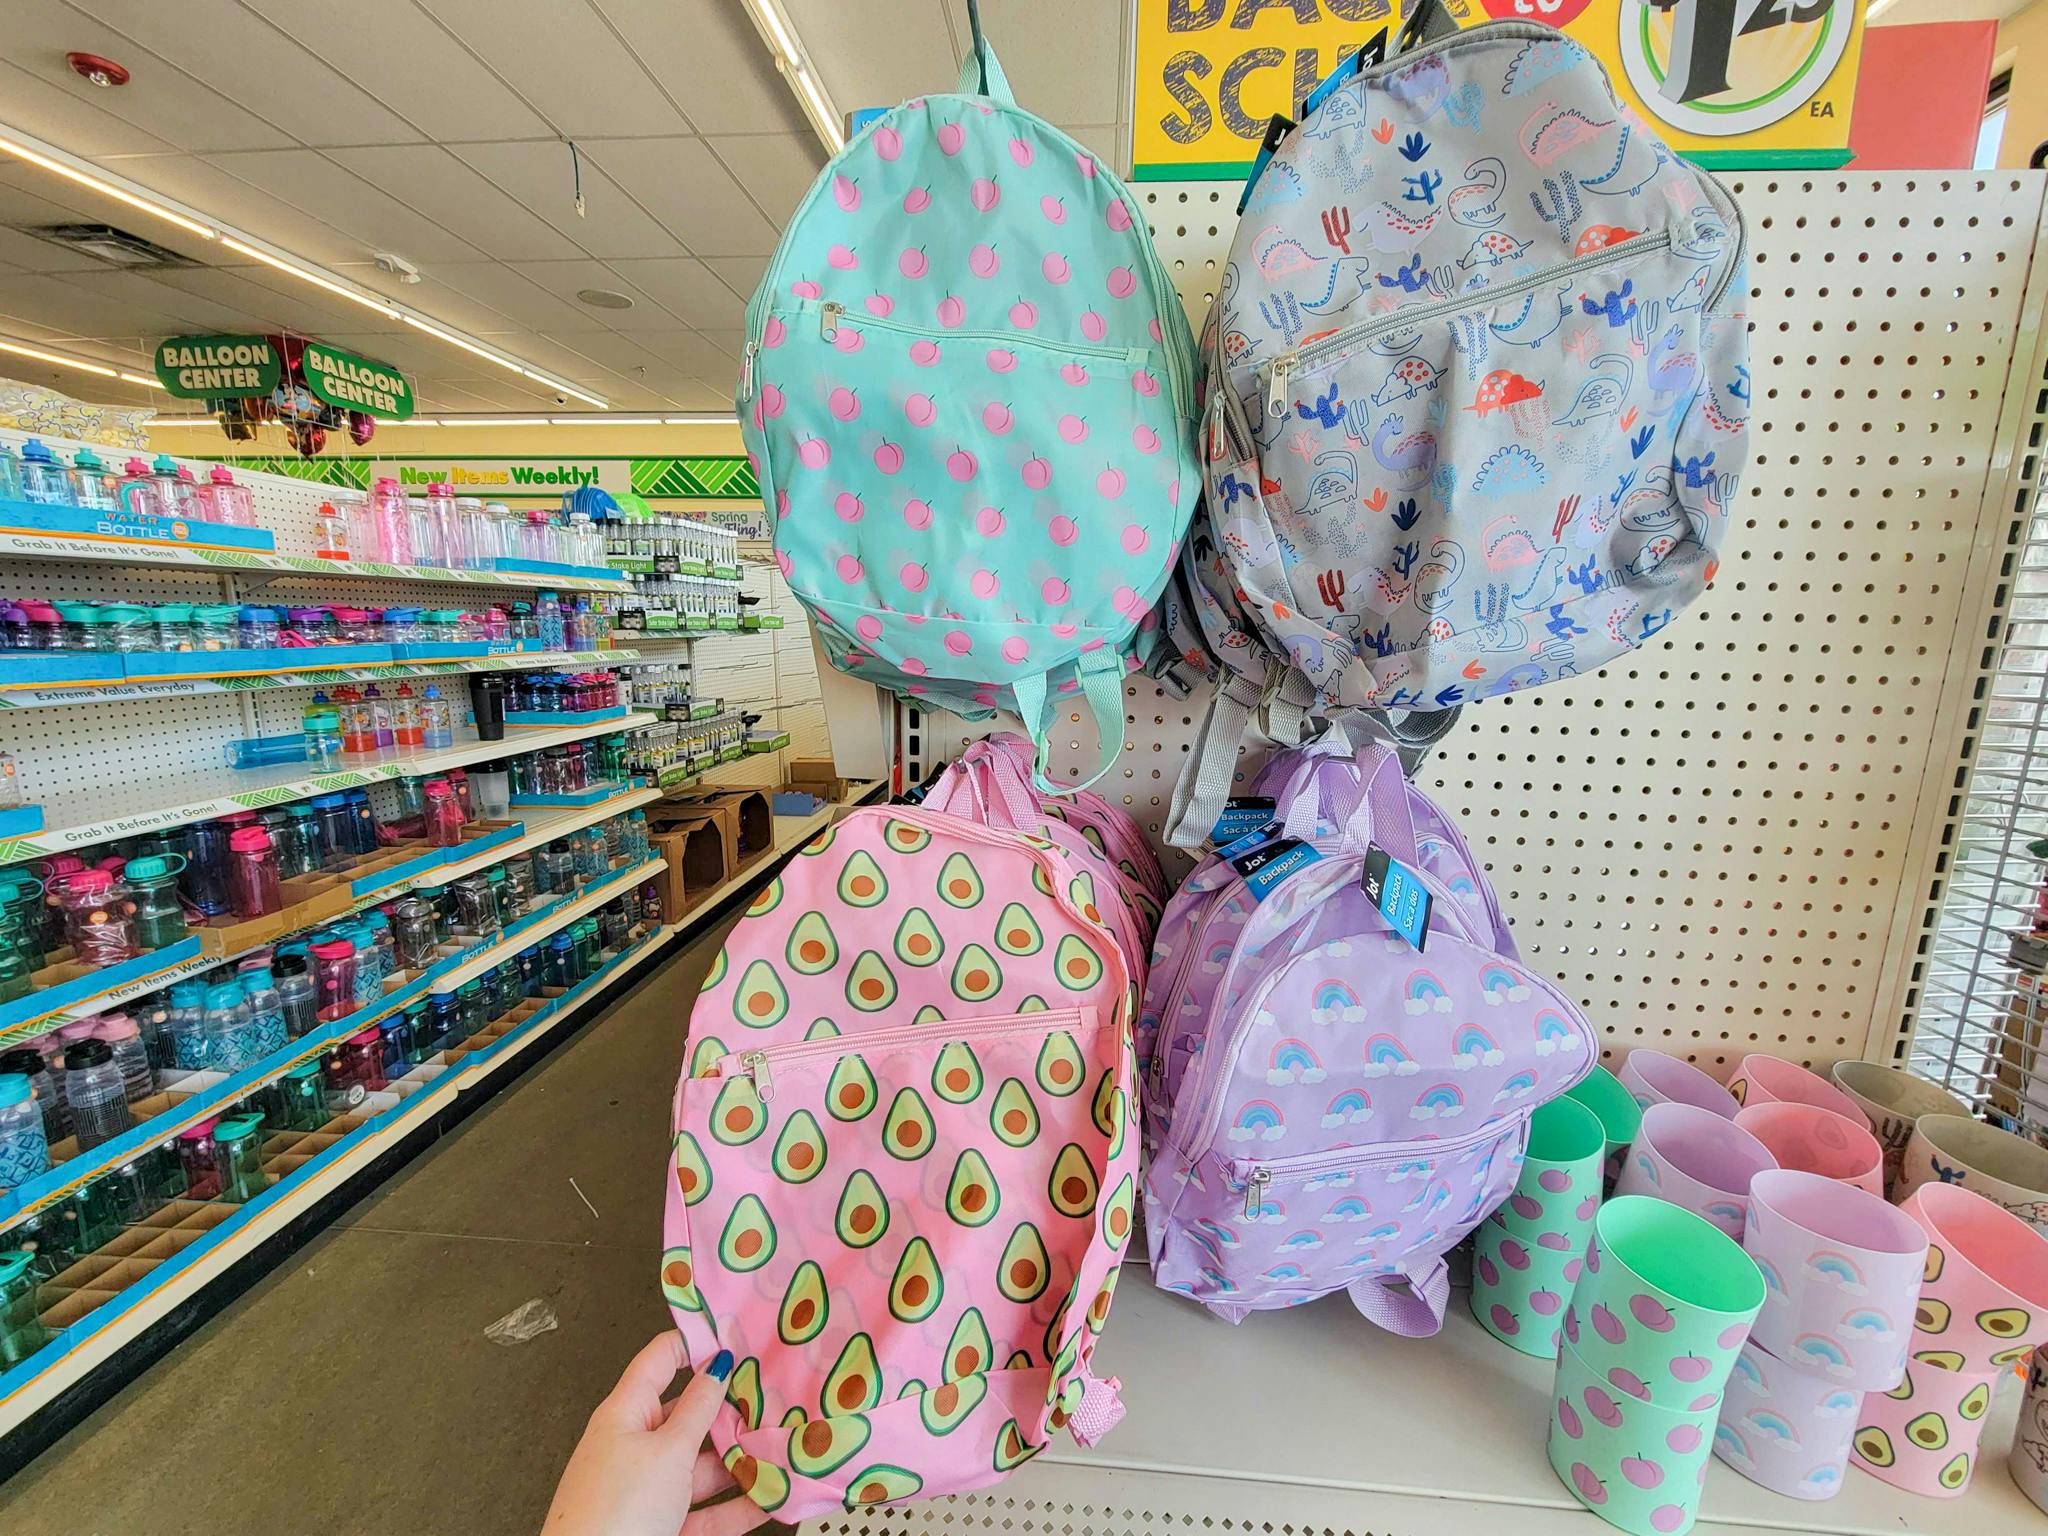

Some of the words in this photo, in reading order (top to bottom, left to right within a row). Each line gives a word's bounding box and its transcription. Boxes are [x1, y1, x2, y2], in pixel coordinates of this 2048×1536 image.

[1811, 101, 1834, 118] EA
[162, 344, 270, 368] BALLOON
[178, 368, 262, 390] CENTER
[308, 350, 405, 397] BALLOON
[322, 376, 399, 415] CENTER
[400, 467, 447, 485] New
[452, 466, 509, 485] Items
[511, 466, 599, 488] Weekly!
[104, 512, 158, 525] WATER
[711, 511, 748, 524] Spring
[97, 521, 170, 540] BOTTLE
[12, 538, 51, 550] Grab
[56, 539, 67, 550] It
[70, 541, 114, 555] Before
[118, 545, 136, 556] It's
[140, 547, 179, 559] Gone!
[35, 687, 95, 701] Extreme
[98, 685, 136, 697] Value
[138, 682, 196, 695] Everyday
[65, 828, 102, 843] Grab
[103, 824, 115, 834] It
[118, 816, 161, 832] Before
[163, 811, 181, 822] It's
[182, 804, 218, 817] Gone!
[1221, 812, 1269, 822] Backpack
[1223, 826, 1240, 835] Sac
[1244, 856, 1266, 871] Jot
[1258, 850, 1305, 886] Backpack
[1366, 877, 1380, 900] Jot
[1386, 873, 1402, 917] Backpack
[1403, 912, 1413, 931] Sac
[1408, 889, 1419, 907] dos
[108, 984, 140, 1001] New
[143, 970, 178, 988] Items
